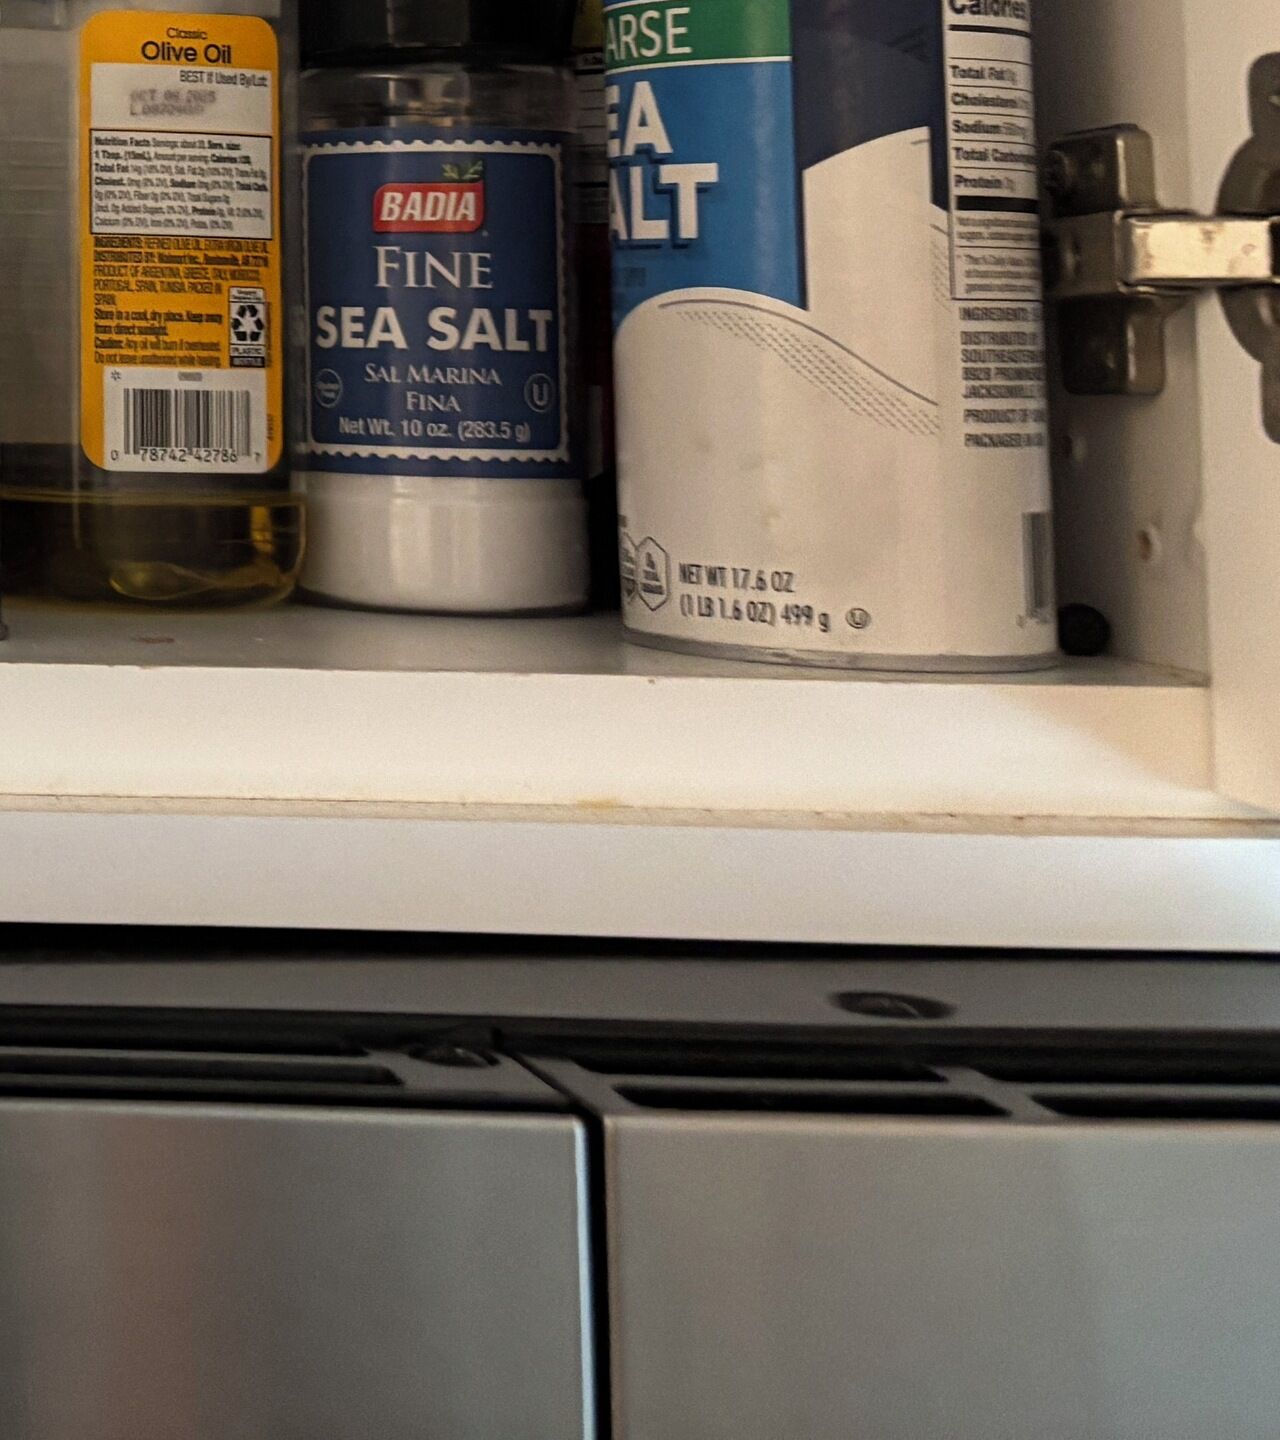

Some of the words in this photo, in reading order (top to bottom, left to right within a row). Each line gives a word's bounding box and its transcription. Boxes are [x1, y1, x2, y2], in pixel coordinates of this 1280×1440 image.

[166, 27, 208, 40] Classic
[606, 8, 693, 60] ARSE
[142, 41, 197, 61] Olive
[204, 44, 231, 64] Oil
[180, 70, 204, 83] BEST
[215, 72, 237, 84] Used
[950, 65, 984, 80] Total
[606, 81, 673, 157] EA
[380, 192, 477, 222] BADIA
[610, 163, 719, 240] ALT
[373, 246, 494, 289] FINE
[315, 306, 408, 349] SEA
[426, 307, 553, 352] SALT
[365, 363, 401, 384] SAL
[407, 366, 502, 385] MARINA
[406, 392, 461, 412] FINA
[339, 417, 365, 434] Net
[368, 418, 394, 435] Wt.
[401, 419, 423, 436] 10
[141, 449, 187, 461] 78742
[194, 450, 238, 462] 42786
[679, 563, 702, 584] NET
[706, 565, 727, 587] WT
[733, 567, 767, 590] 17.6
[771, 571, 796, 592] OZ
[698, 596, 713, 617] LB
[719, 598, 741, 620] 1.6
[747, 601, 776, 627] OZ)
[781, 603, 814, 626] 499
[819, 613, 831, 632] g
